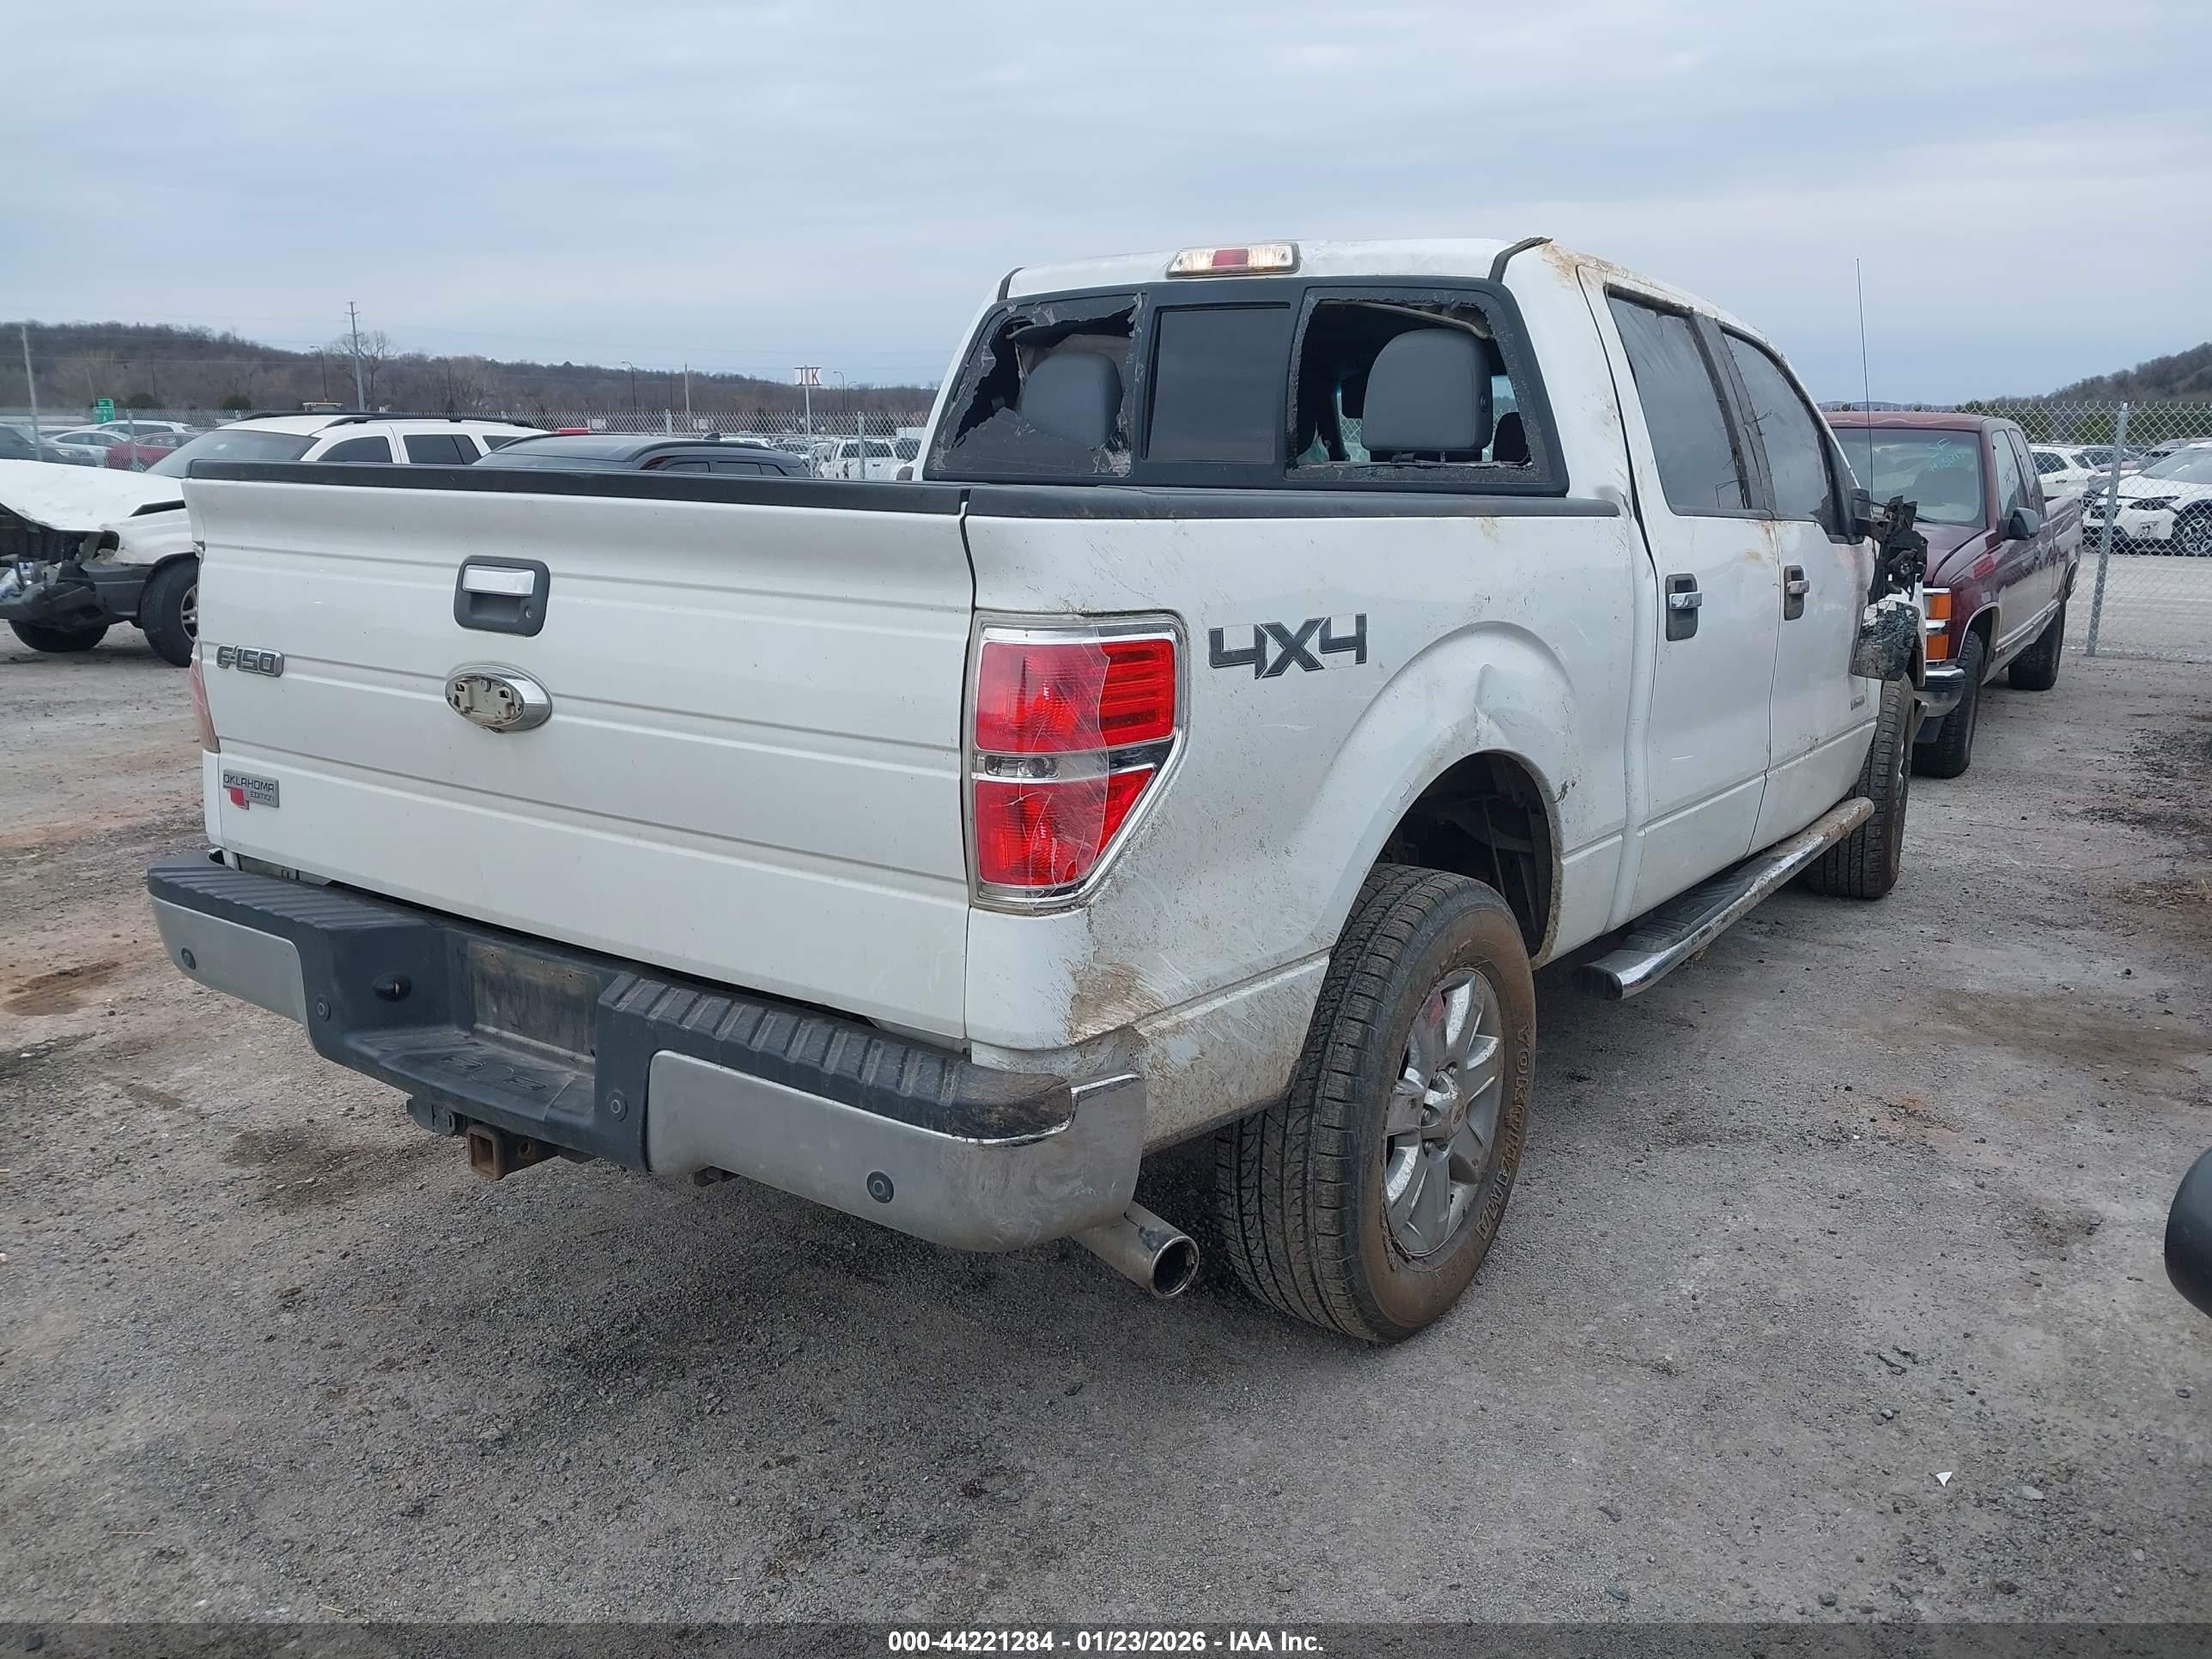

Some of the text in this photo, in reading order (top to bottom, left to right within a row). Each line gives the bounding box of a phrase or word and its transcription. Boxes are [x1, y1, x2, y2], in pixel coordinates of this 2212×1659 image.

[217, 646, 278, 674] F-150
[1209, 613, 1367, 679] 4X4
[223, 774, 275, 793] OKLAHOMA
